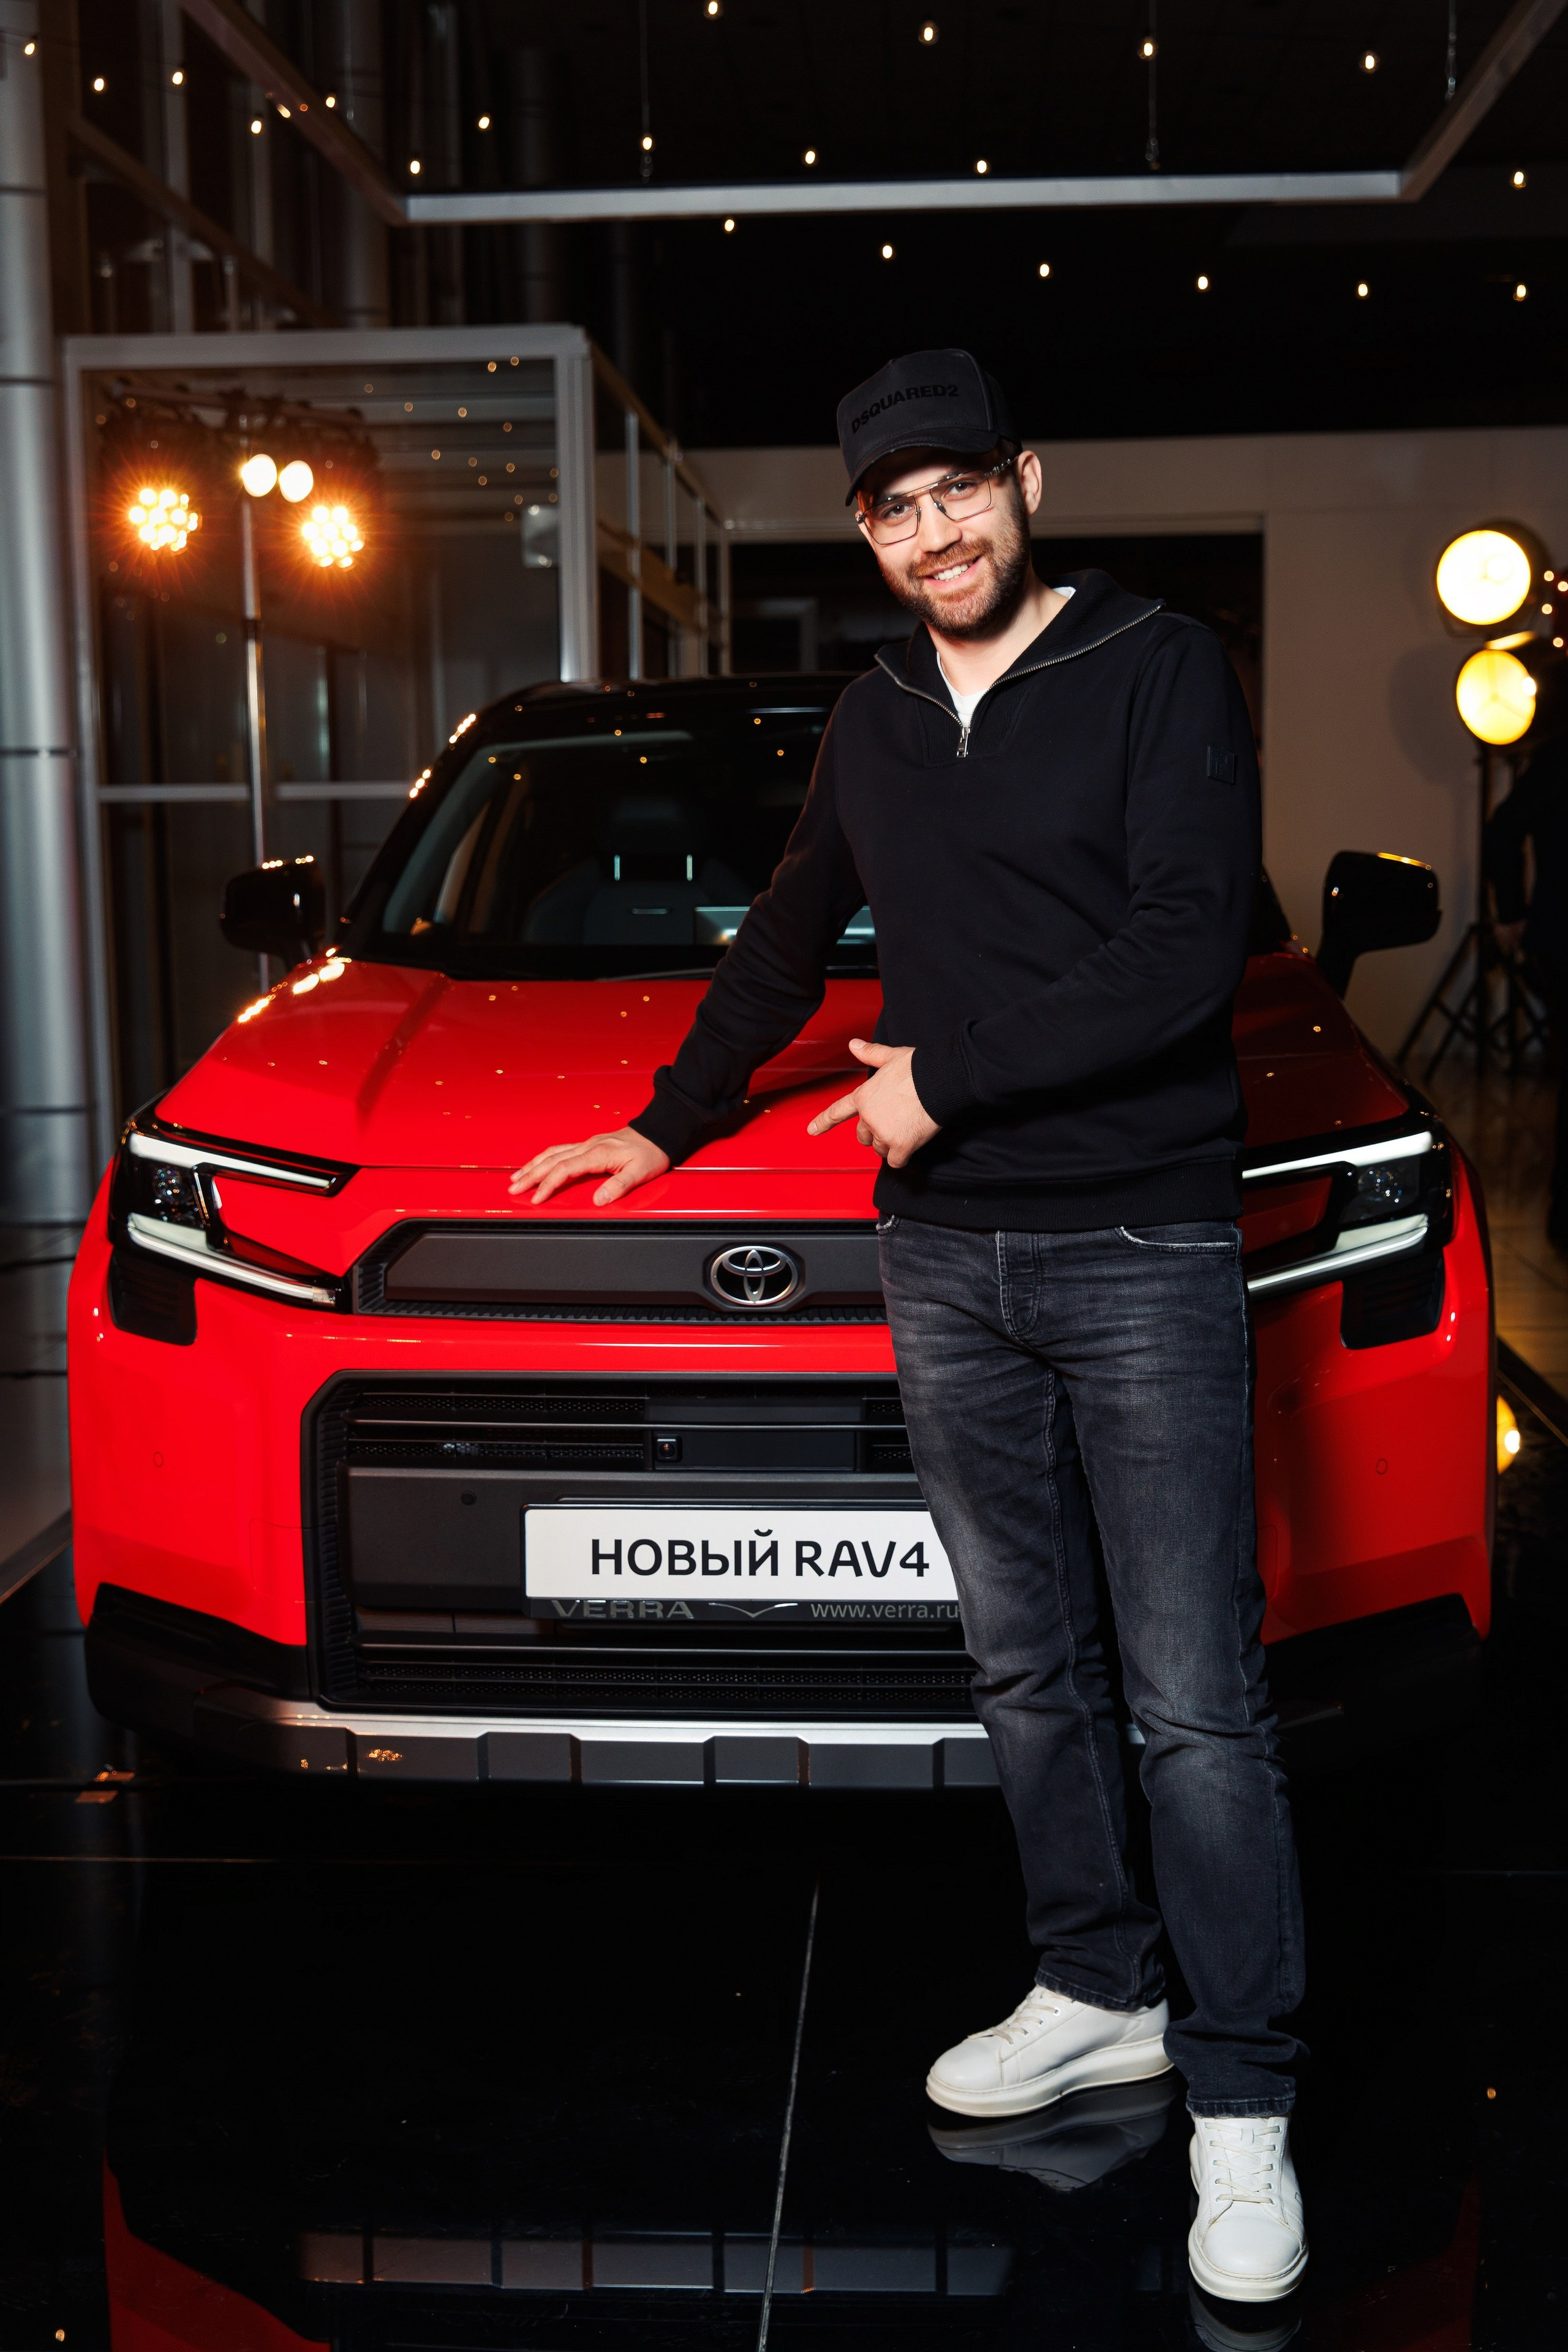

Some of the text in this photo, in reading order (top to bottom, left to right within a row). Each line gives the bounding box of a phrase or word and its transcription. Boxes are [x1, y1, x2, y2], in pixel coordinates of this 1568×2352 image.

[851, 385, 959, 434] DSQUARED2
[591, 1529, 930, 1578] НОВЫЙ RAV4
[551, 1599, 695, 1619] VERRA
[810, 1604, 959, 1618] www.verra.ru
